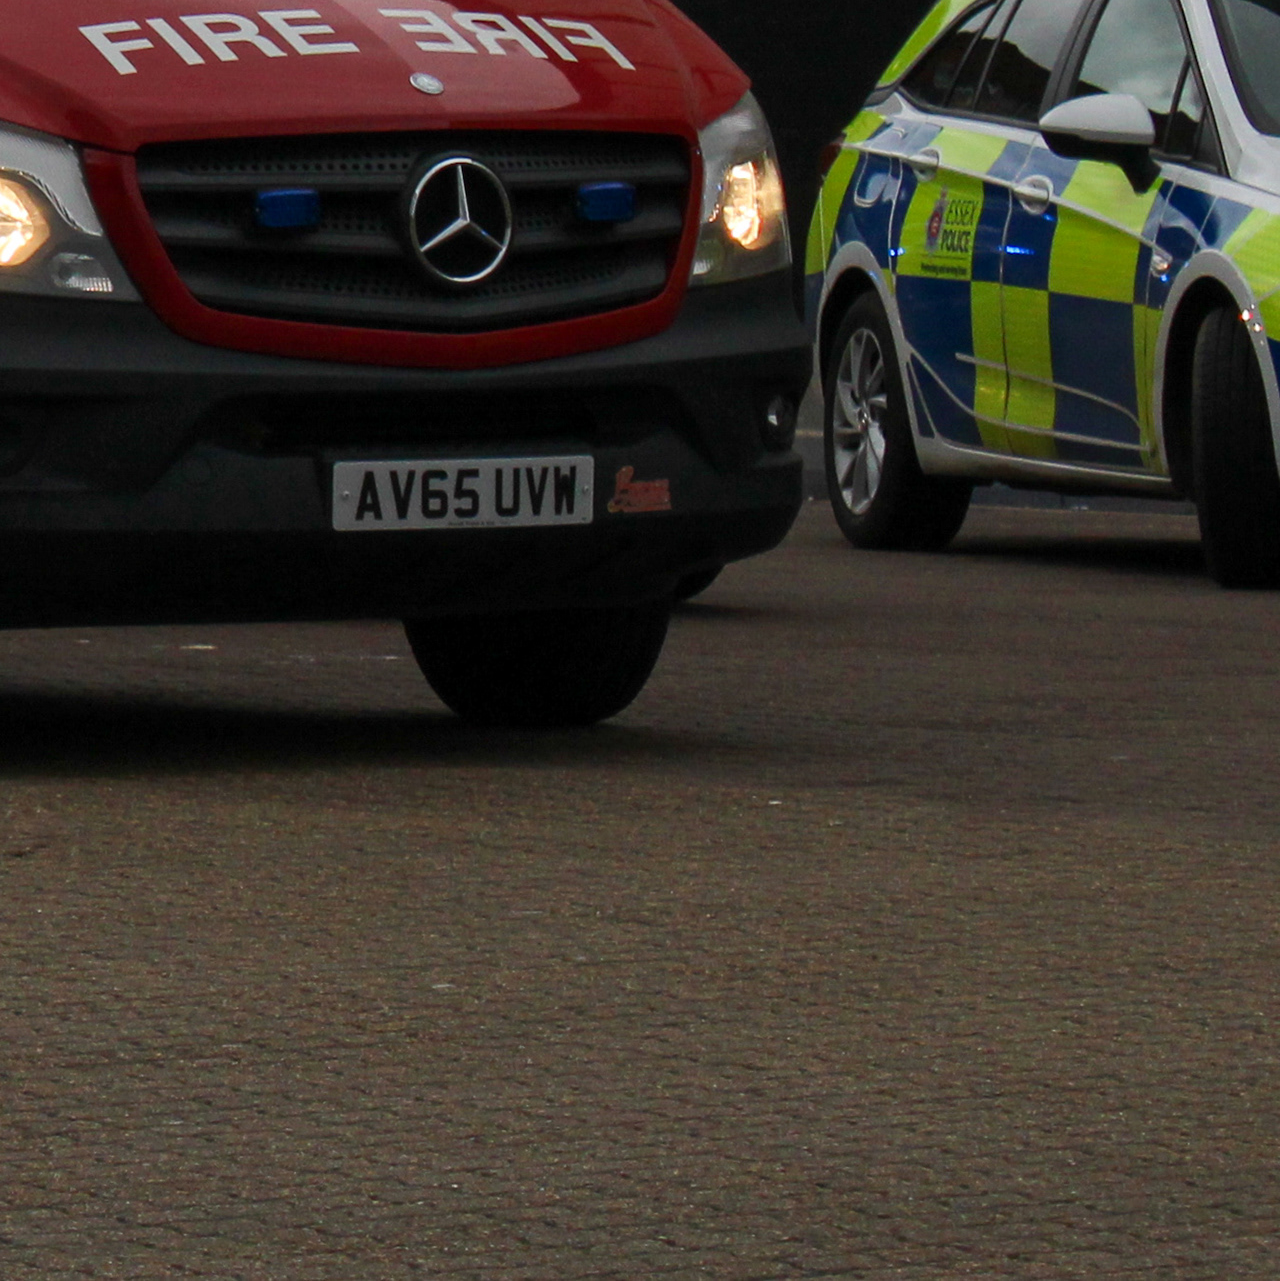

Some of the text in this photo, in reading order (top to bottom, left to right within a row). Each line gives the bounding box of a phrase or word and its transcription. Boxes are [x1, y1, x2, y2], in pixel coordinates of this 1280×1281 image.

[78, 9, 360, 75] FIRE
[946, 199, 979, 226] ESSEX
[940, 229, 971, 253] POLICE
[355, 465, 577, 520] AV65 UVW
